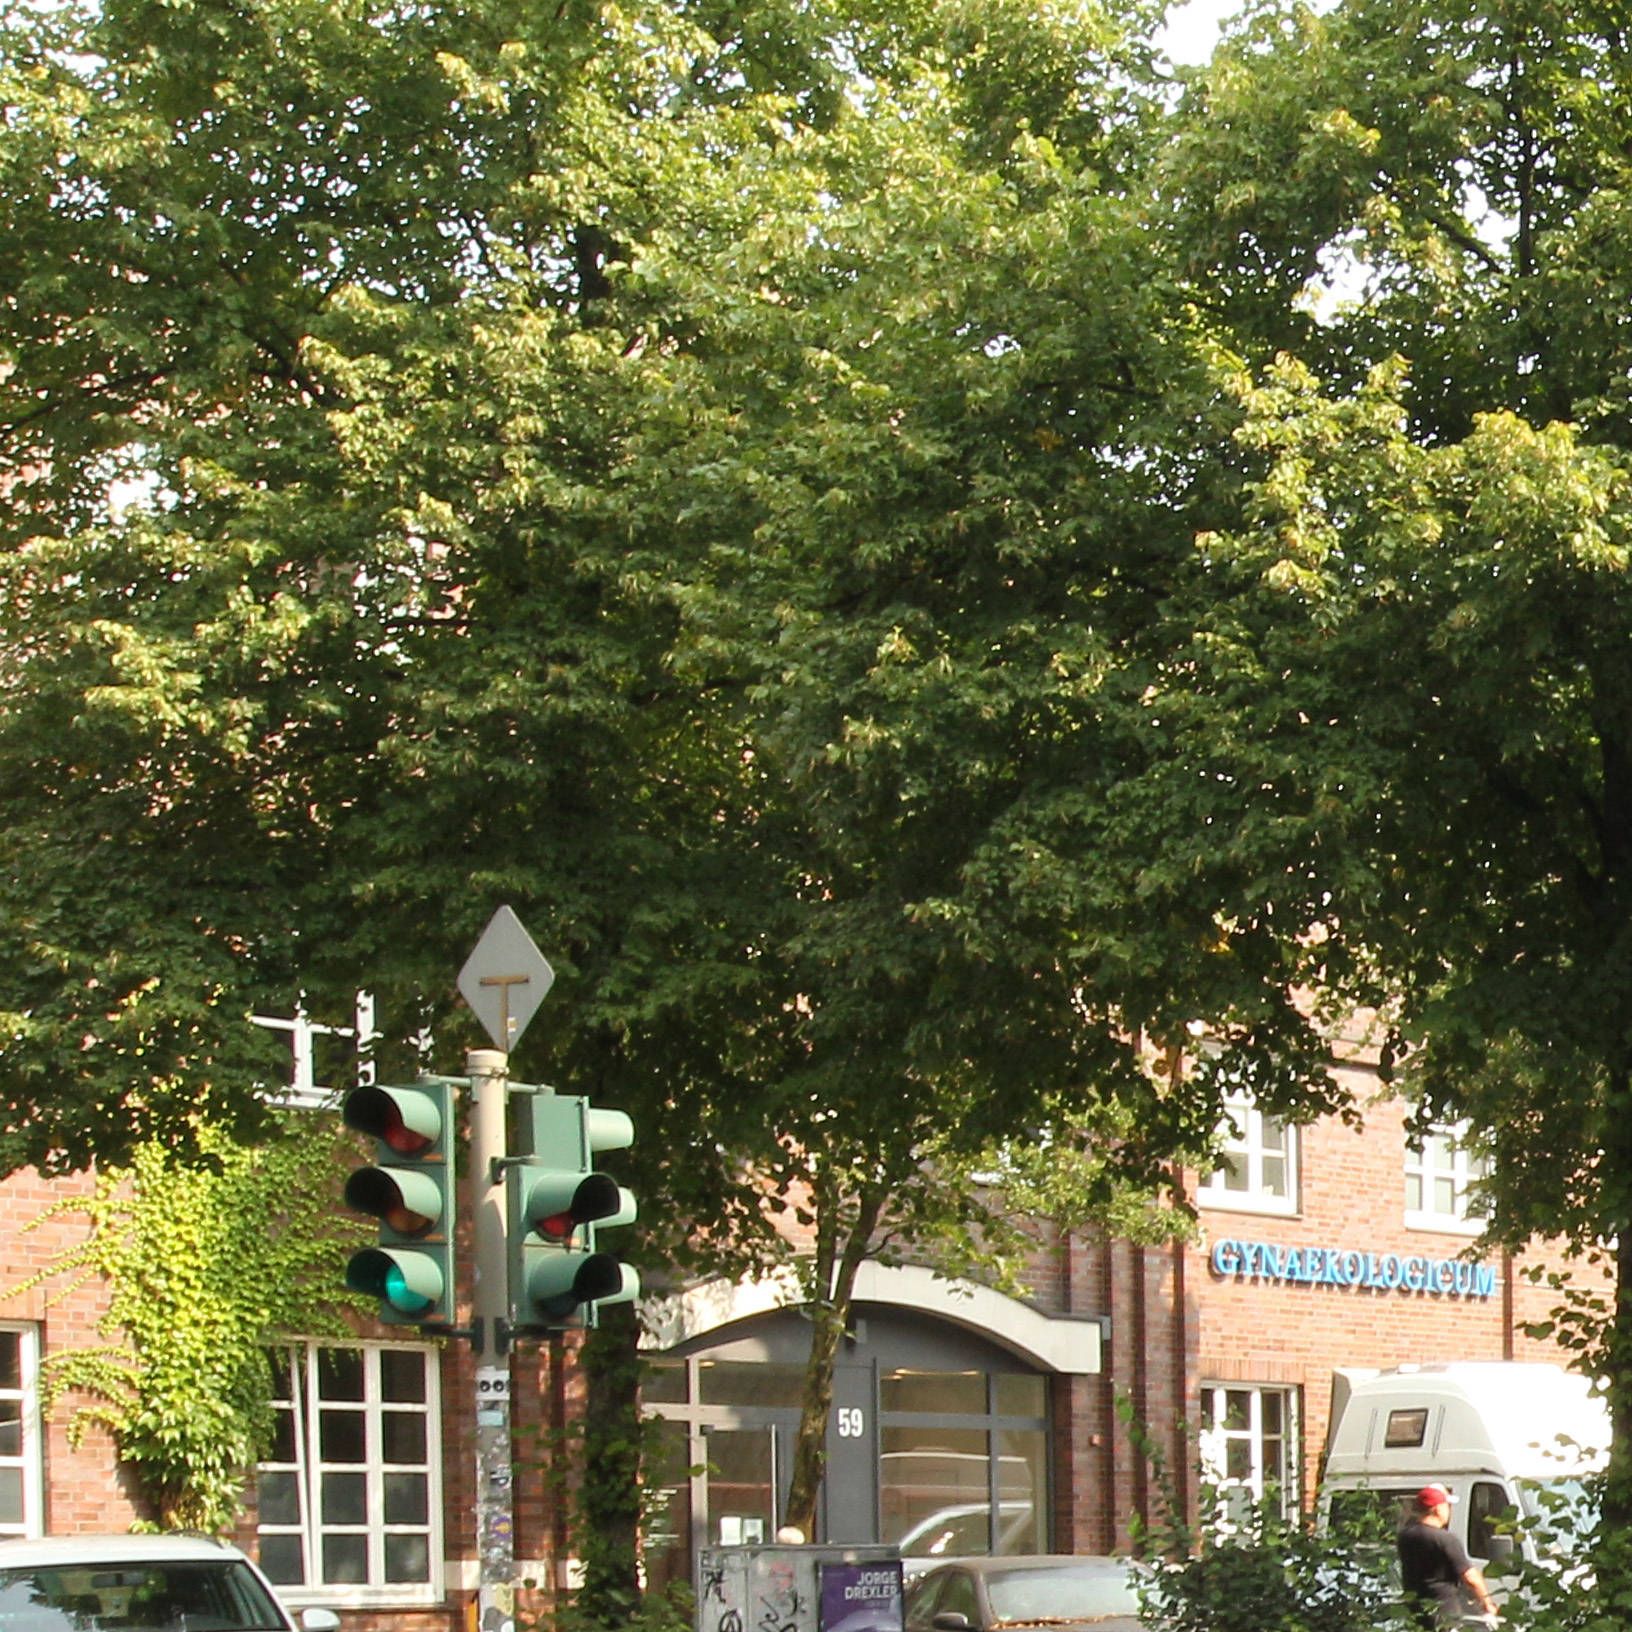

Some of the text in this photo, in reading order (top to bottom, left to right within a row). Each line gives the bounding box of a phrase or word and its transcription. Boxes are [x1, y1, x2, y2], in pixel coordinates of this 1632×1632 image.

[1211, 1239, 1498, 1297] GYNAEKOLOGICUM
[837, 1407, 864, 1438] 59
[857, 1570, 898, 1585] JORGE
[844, 1585, 898, 1600] DREXLER
